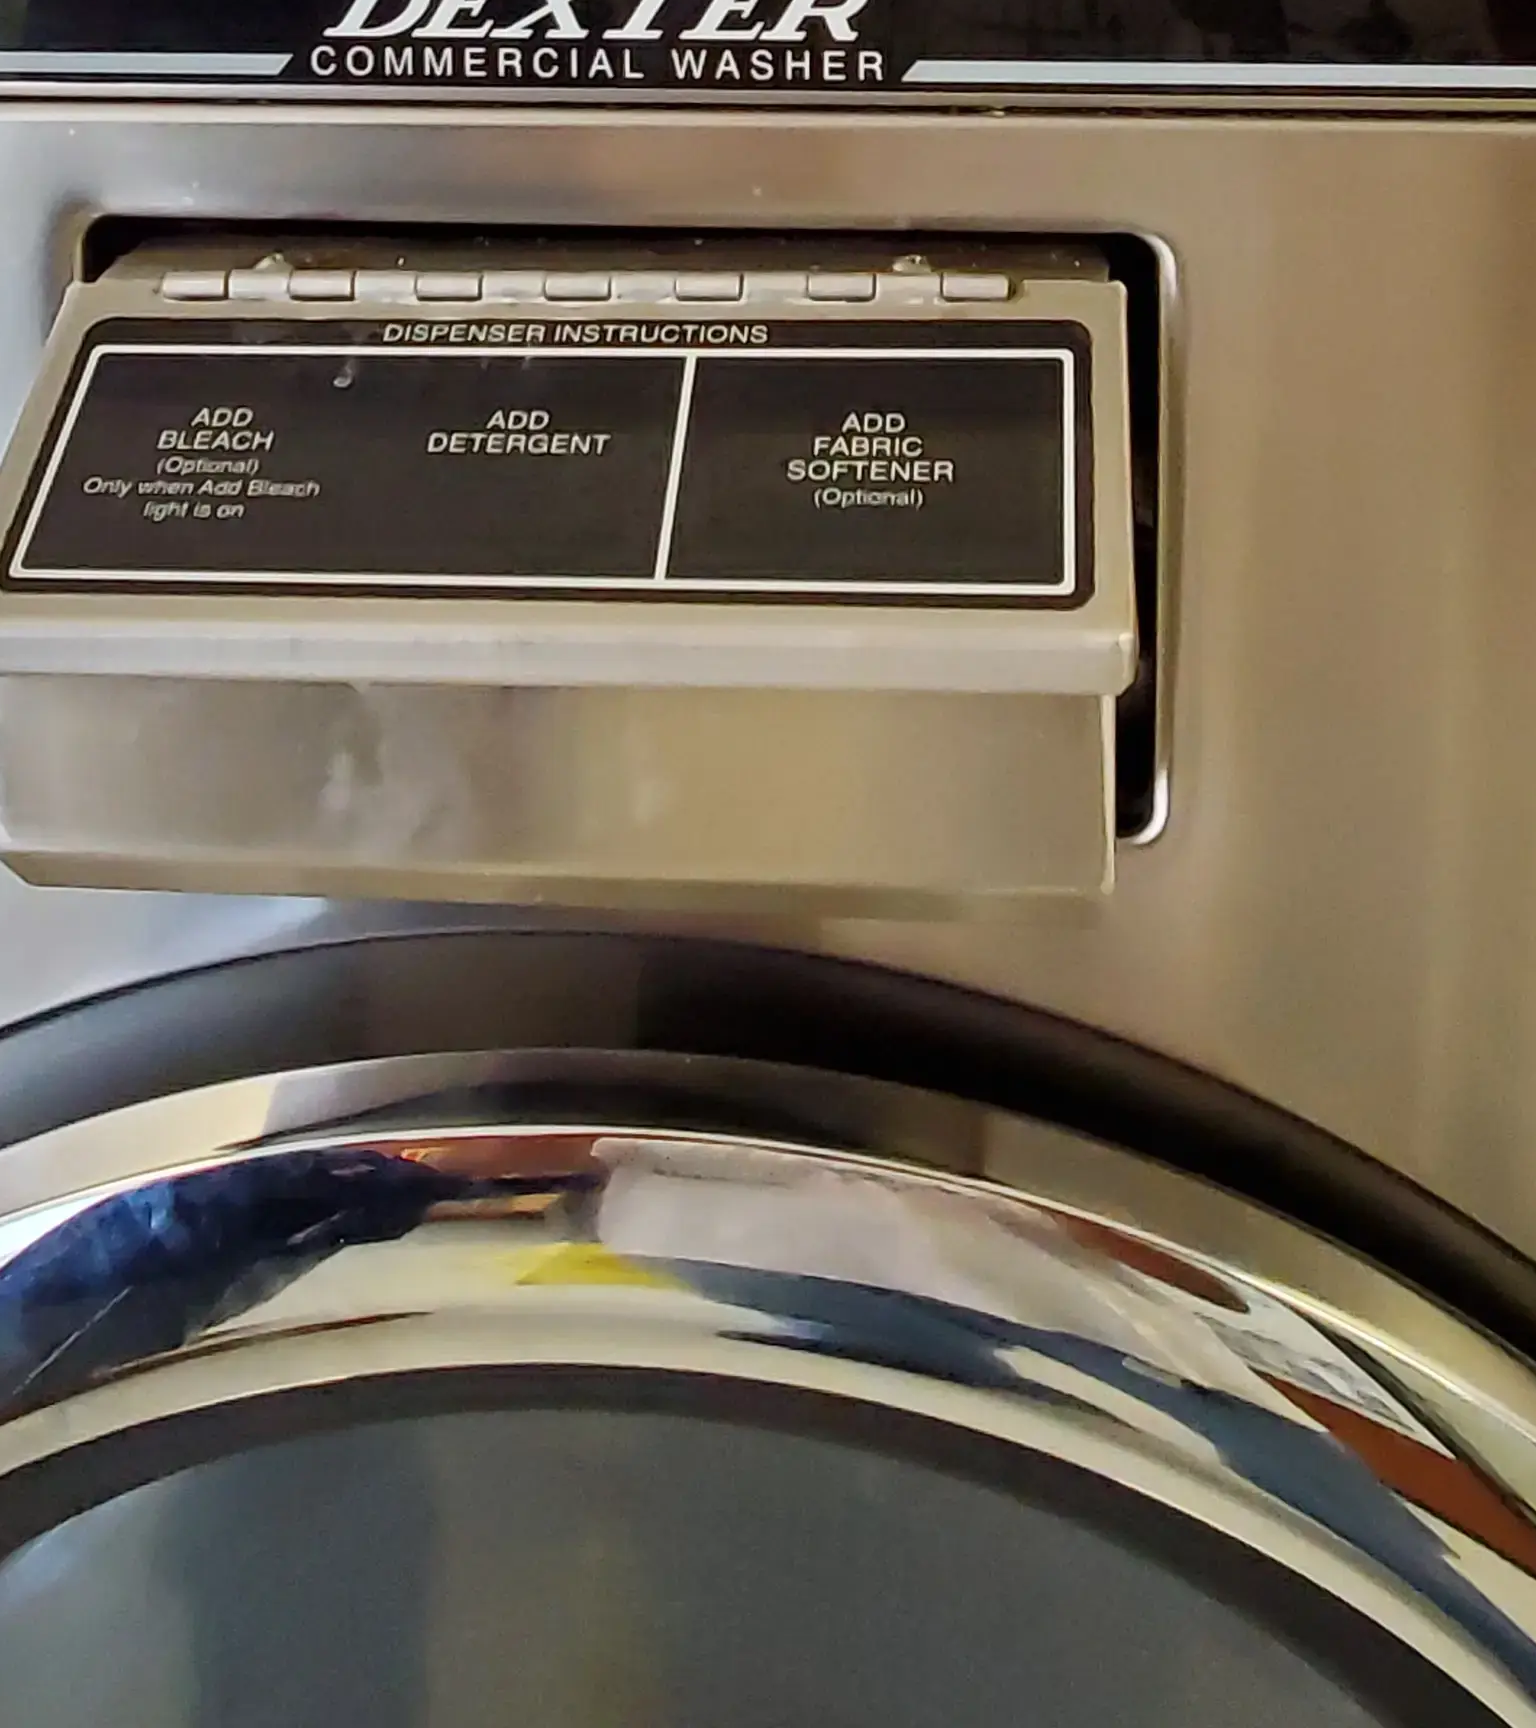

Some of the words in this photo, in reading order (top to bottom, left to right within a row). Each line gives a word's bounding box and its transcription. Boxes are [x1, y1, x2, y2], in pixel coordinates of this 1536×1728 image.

[310, 45, 645, 79] COMMERCIAL
[671, 48, 885, 82] WASHER
[382, 322, 547, 344] DISPENSER
[553, 323, 769, 346] INSTRUCTIONS
[191, 407, 253, 428] ADD
[486, 409, 551, 433] ADD
[841, 411, 907, 434] ADD
[156, 429, 276, 453] BLEACH
[426, 432, 612, 457] DETERGENT
[812, 435, 924, 458] FABRIC
[156, 455, 260, 477] (Optional)
[785, 458, 956, 484] SOFTENER
[83, 476, 134, 499] Only
[137, 478, 195, 496] when
[197, 478, 243, 497] Add
[246, 478, 321, 498] Bleach
[813, 485, 924, 511] (Optional)
[142, 501, 189, 523] light
[193, 501, 212, 520] is
[216, 503, 246, 519] on
